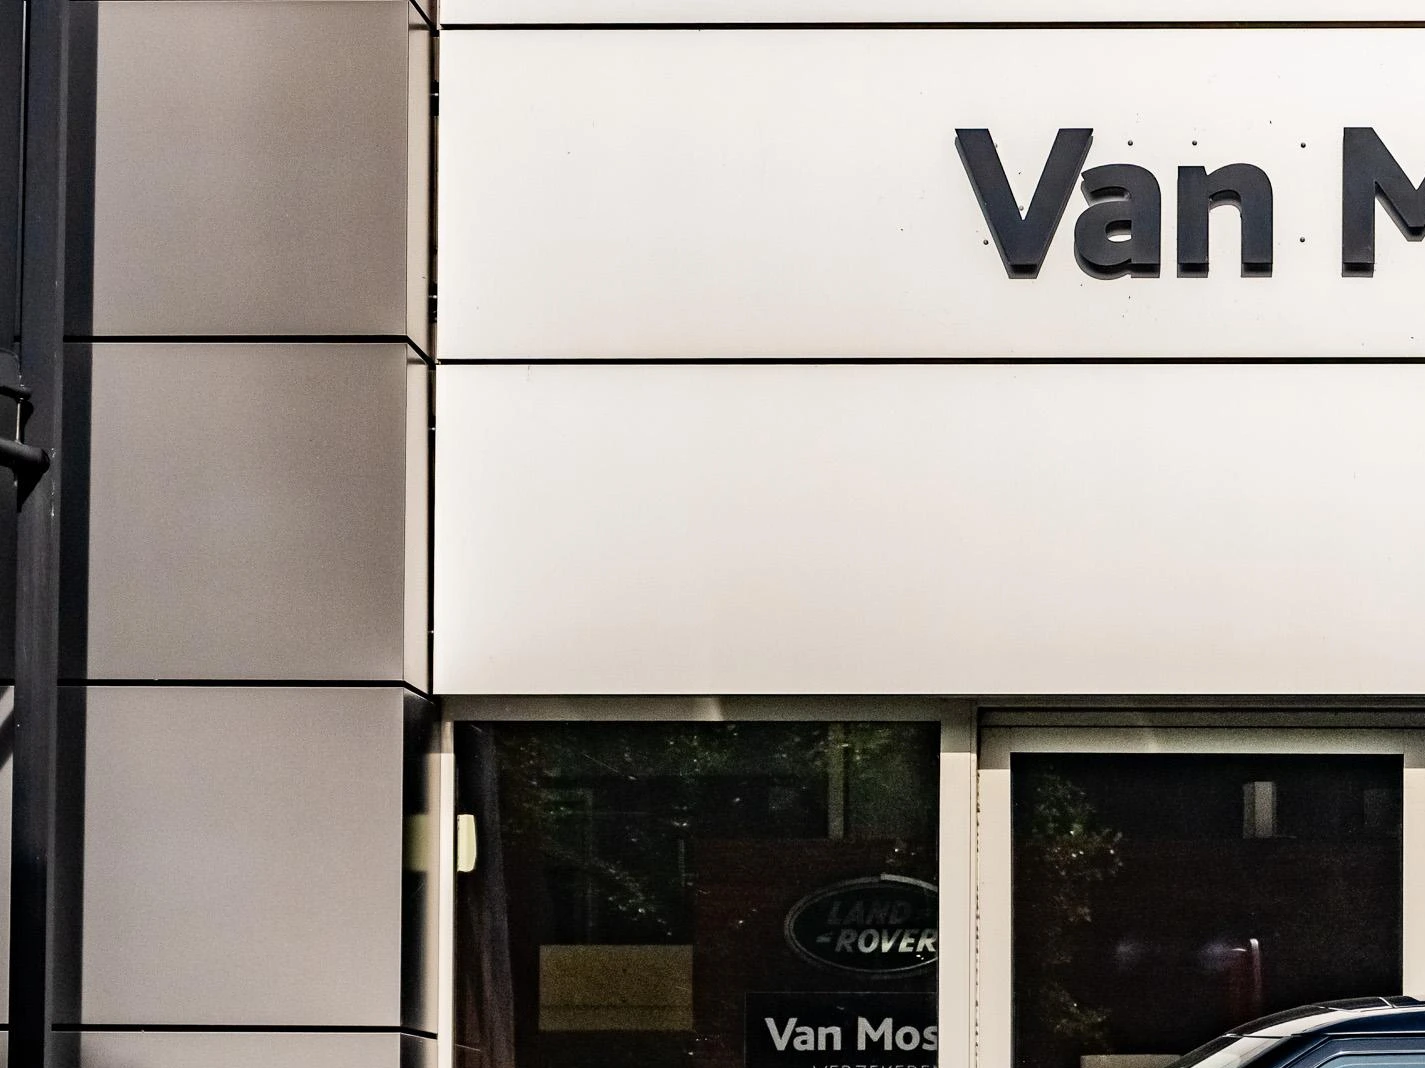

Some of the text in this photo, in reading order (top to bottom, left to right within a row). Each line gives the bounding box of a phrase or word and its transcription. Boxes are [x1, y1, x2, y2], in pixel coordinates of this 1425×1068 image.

[954, 127, 1274, 279] Van
[826, 900, 911, 925] LAND
[834, 928, 938, 953] ROVER
[764, 1016, 842, 1051] Van
